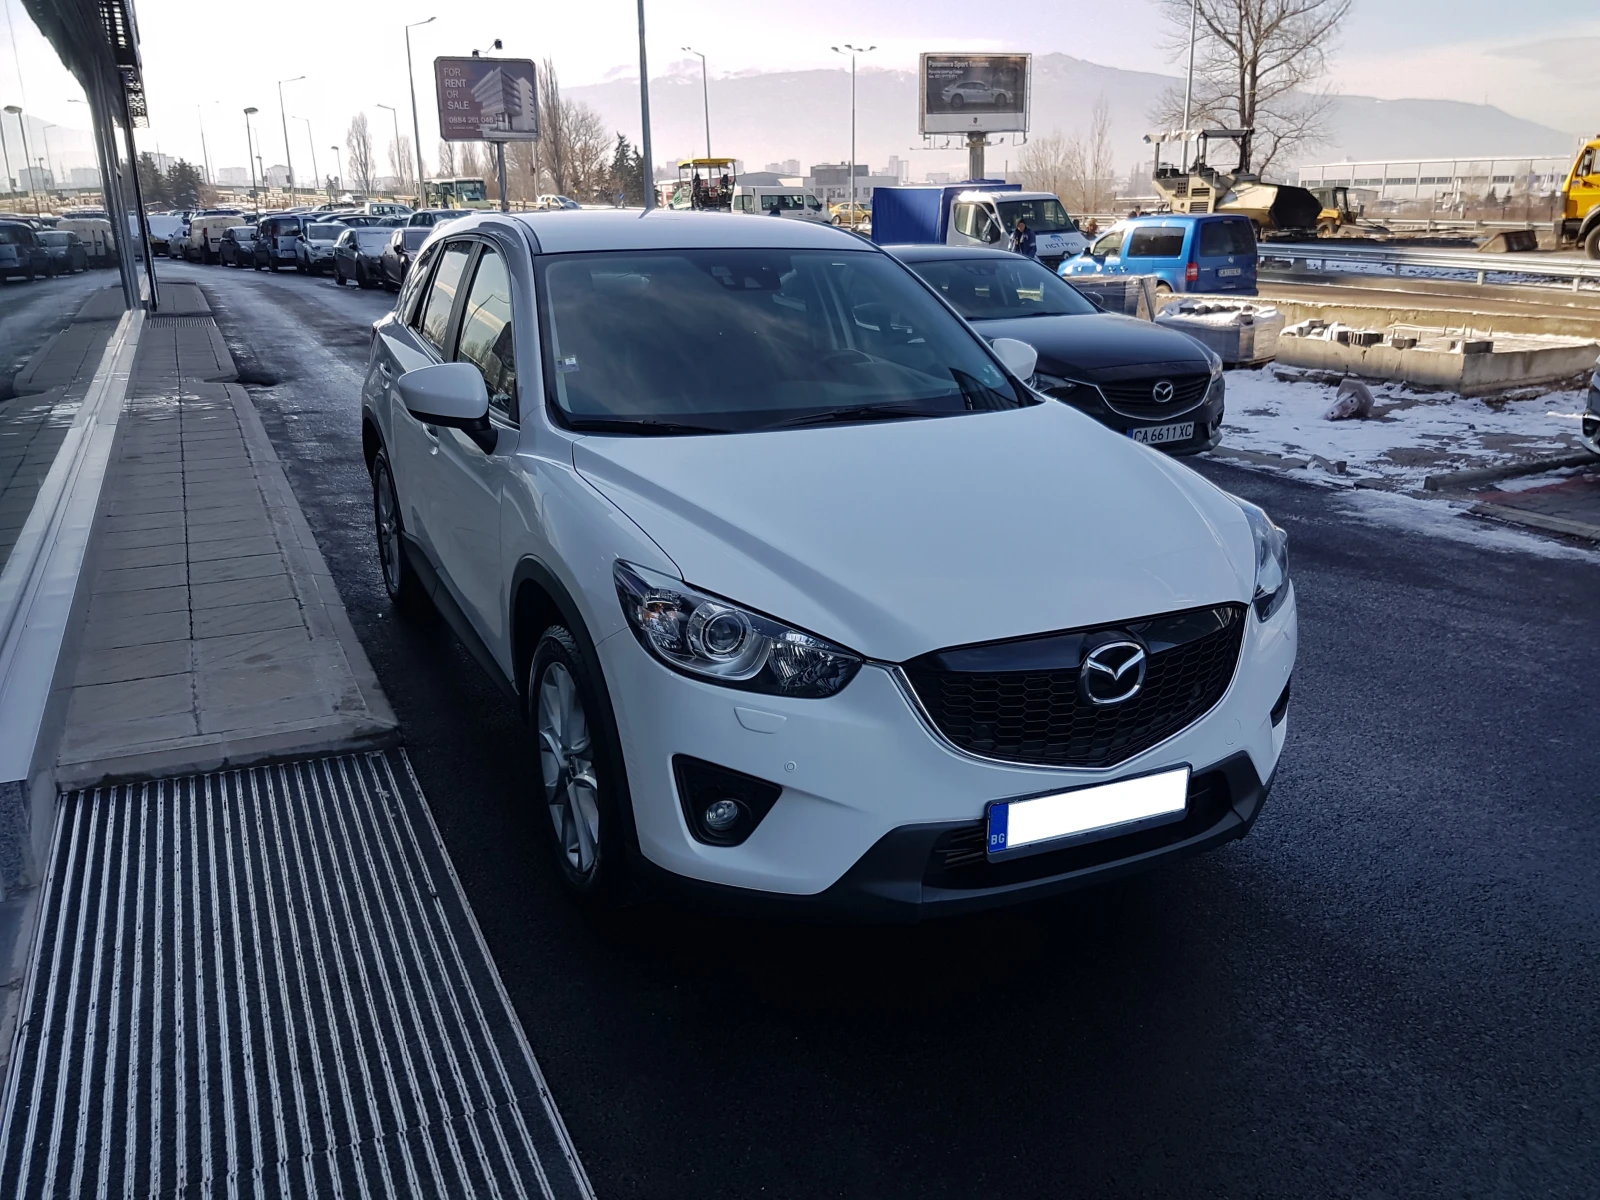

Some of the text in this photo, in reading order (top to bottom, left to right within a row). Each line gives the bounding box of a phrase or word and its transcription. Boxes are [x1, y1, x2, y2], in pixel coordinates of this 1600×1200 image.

[444, 67, 461, 77] FOR
[445, 79, 466, 88] RENT
[446, 90, 459, 99] OR
[447, 101, 469, 110] SALE
[1134, 424, 1193, 443] CA 6611 XC
[991, 833, 1005, 846] BG
